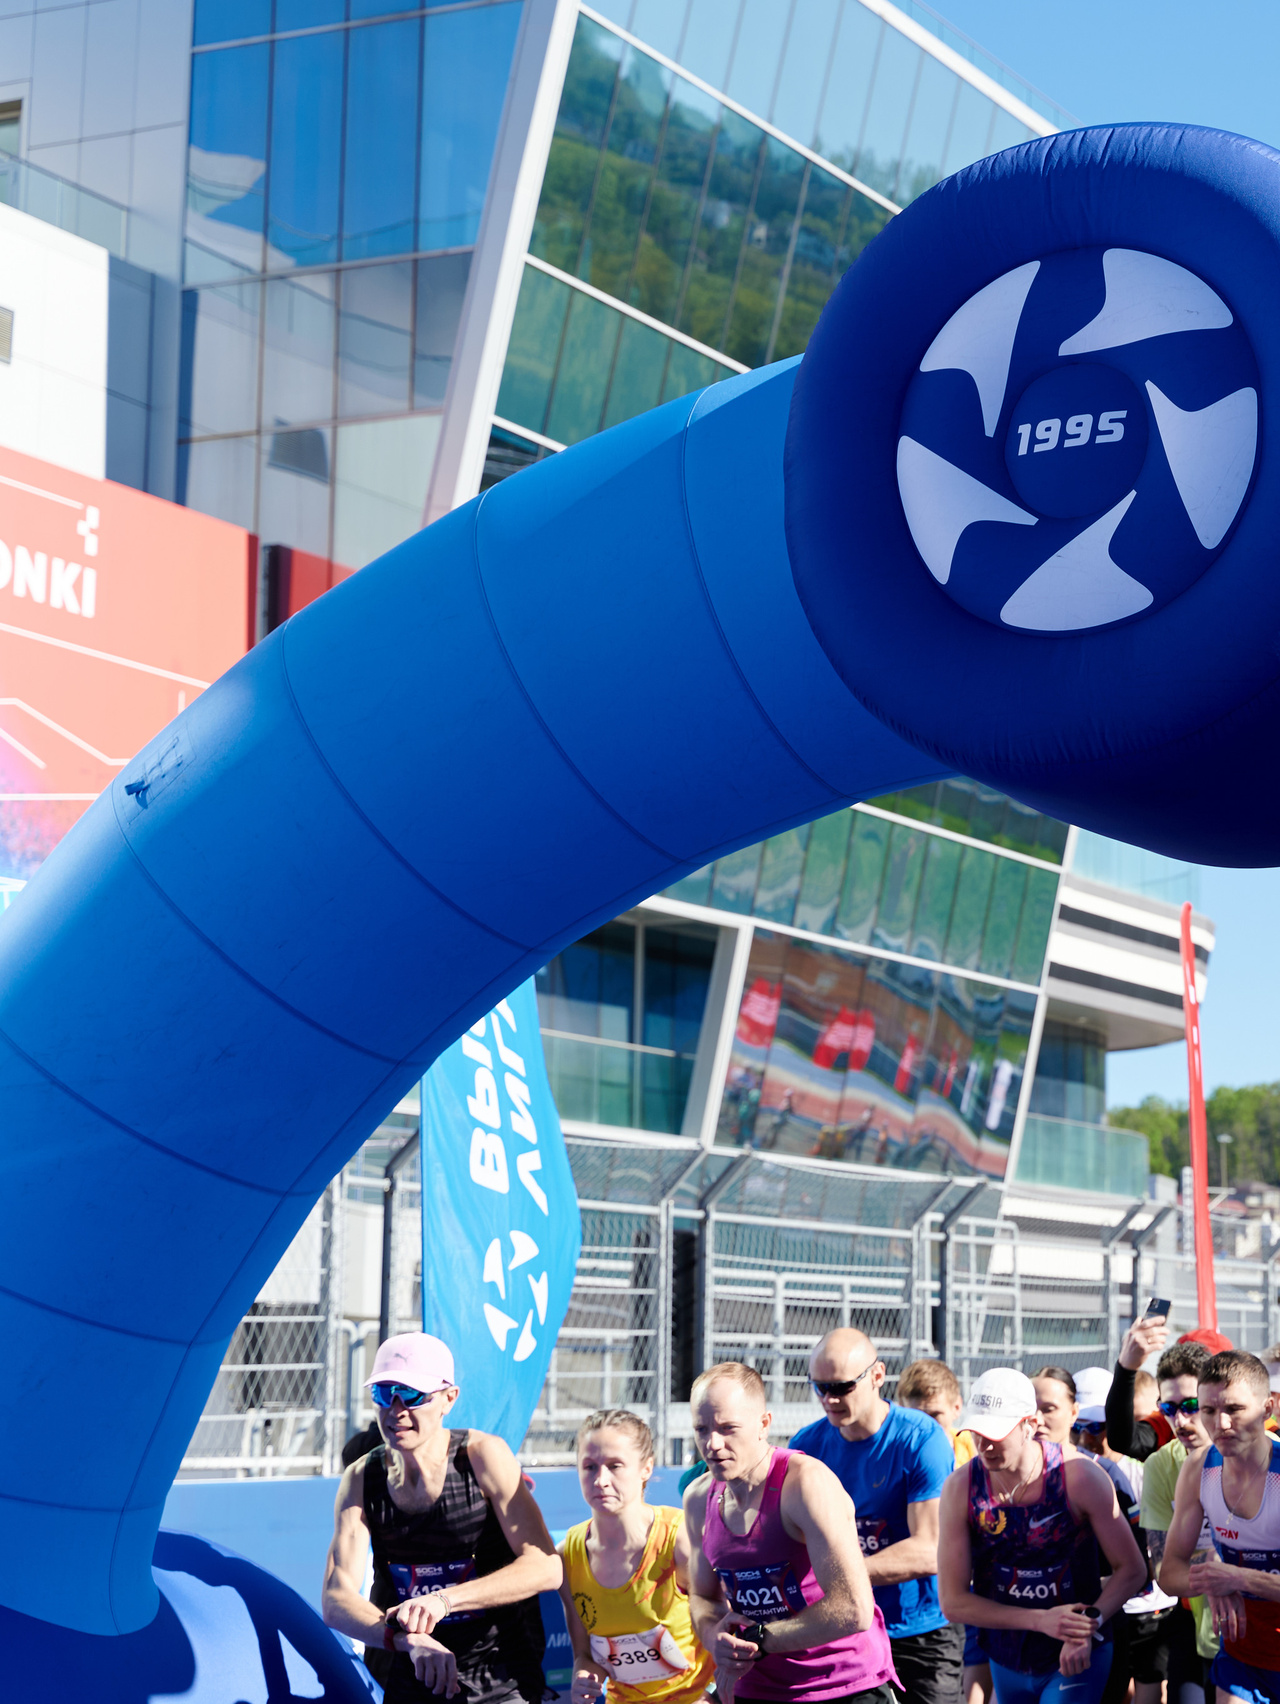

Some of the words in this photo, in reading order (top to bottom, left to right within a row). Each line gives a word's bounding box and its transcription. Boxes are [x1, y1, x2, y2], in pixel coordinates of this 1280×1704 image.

[1017, 410, 1128, 456] 1995
[972, 1394, 1002, 1408] RUSSIA
[736, 1585, 783, 1606] 4021
[1008, 1582, 1057, 1599] 4401
[608, 1648, 661, 1667] 5389
